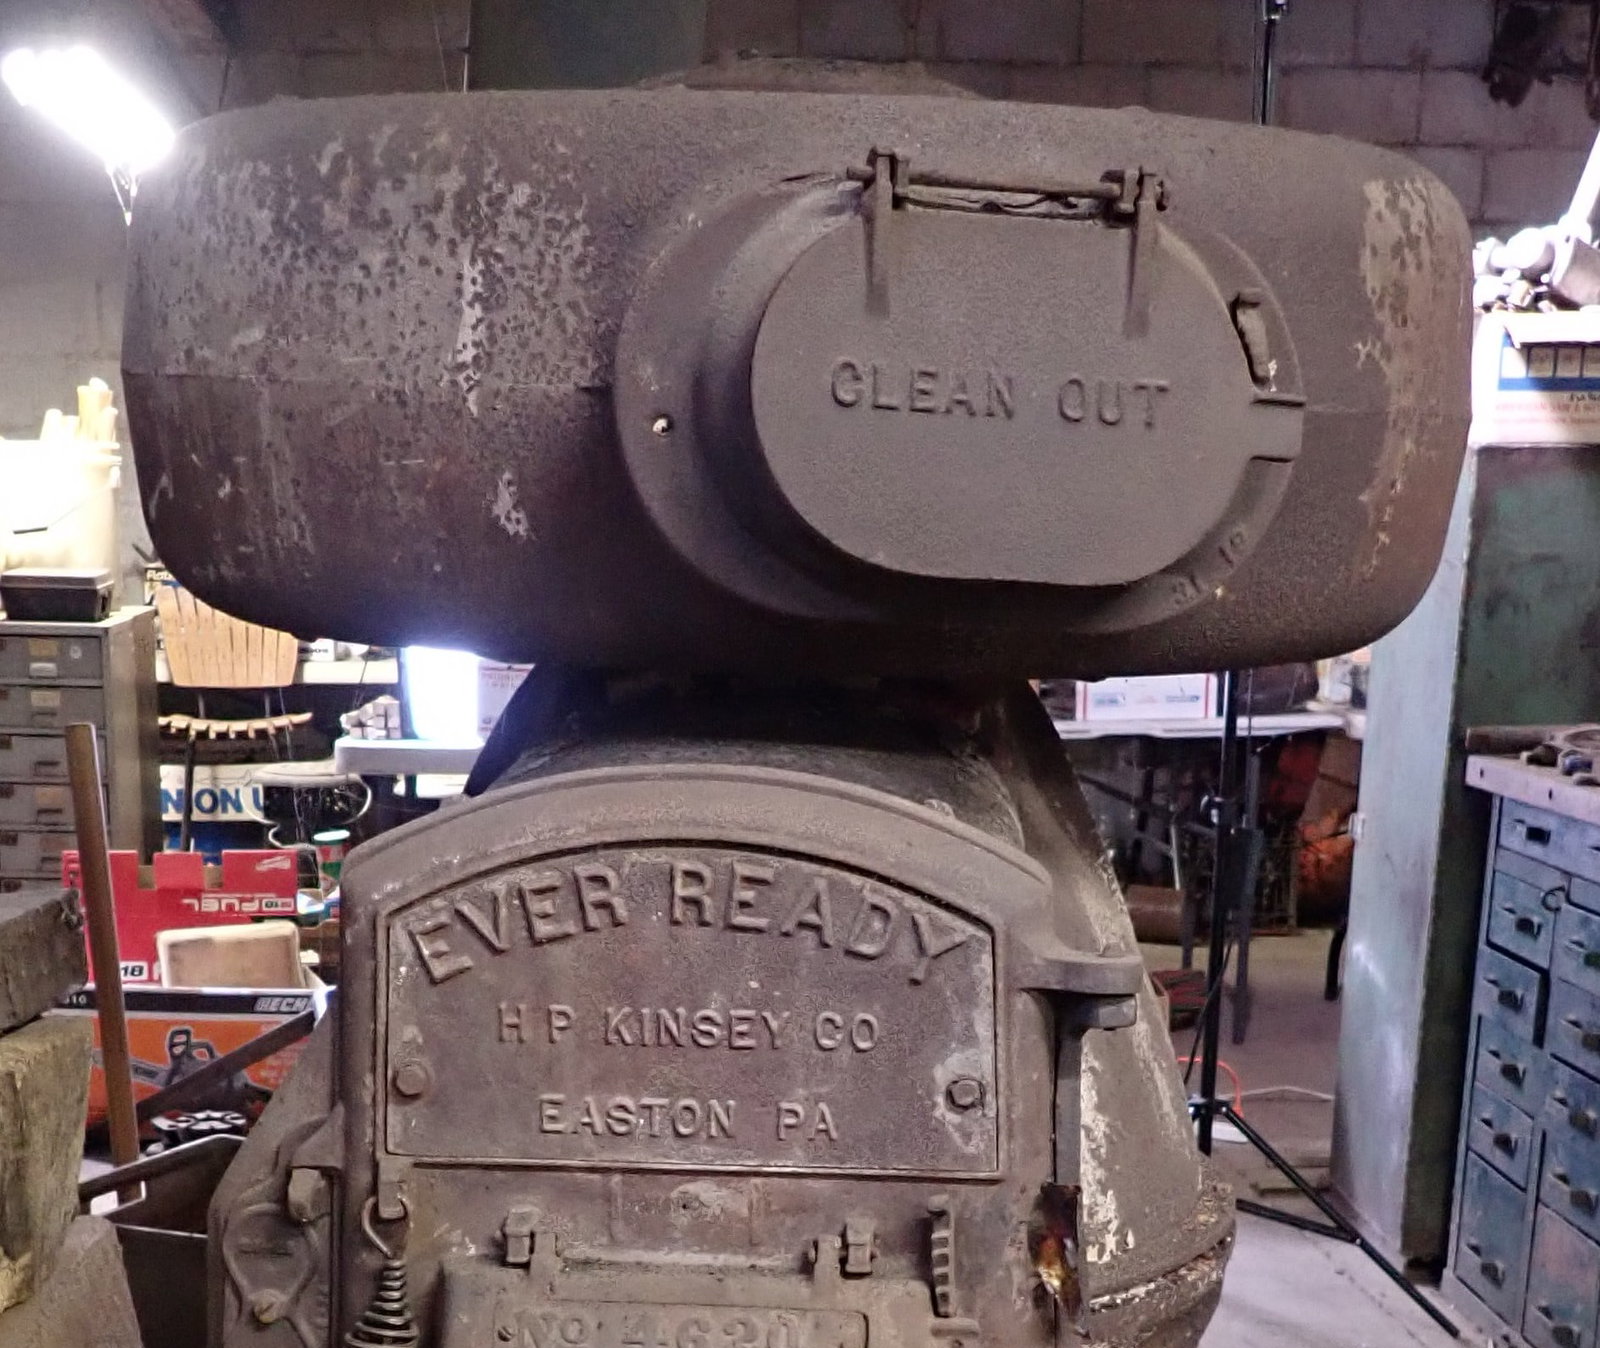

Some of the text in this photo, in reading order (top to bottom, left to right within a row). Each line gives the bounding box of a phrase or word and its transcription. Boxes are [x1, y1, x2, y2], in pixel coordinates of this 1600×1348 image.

[831, 361, 1170, 429] CLEAN OUT
[409, 860, 971, 986] EVER READY
[499, 1004, 879, 1052] H P KINSEY CO
[539, 1095, 838, 1142] EASTON PA
